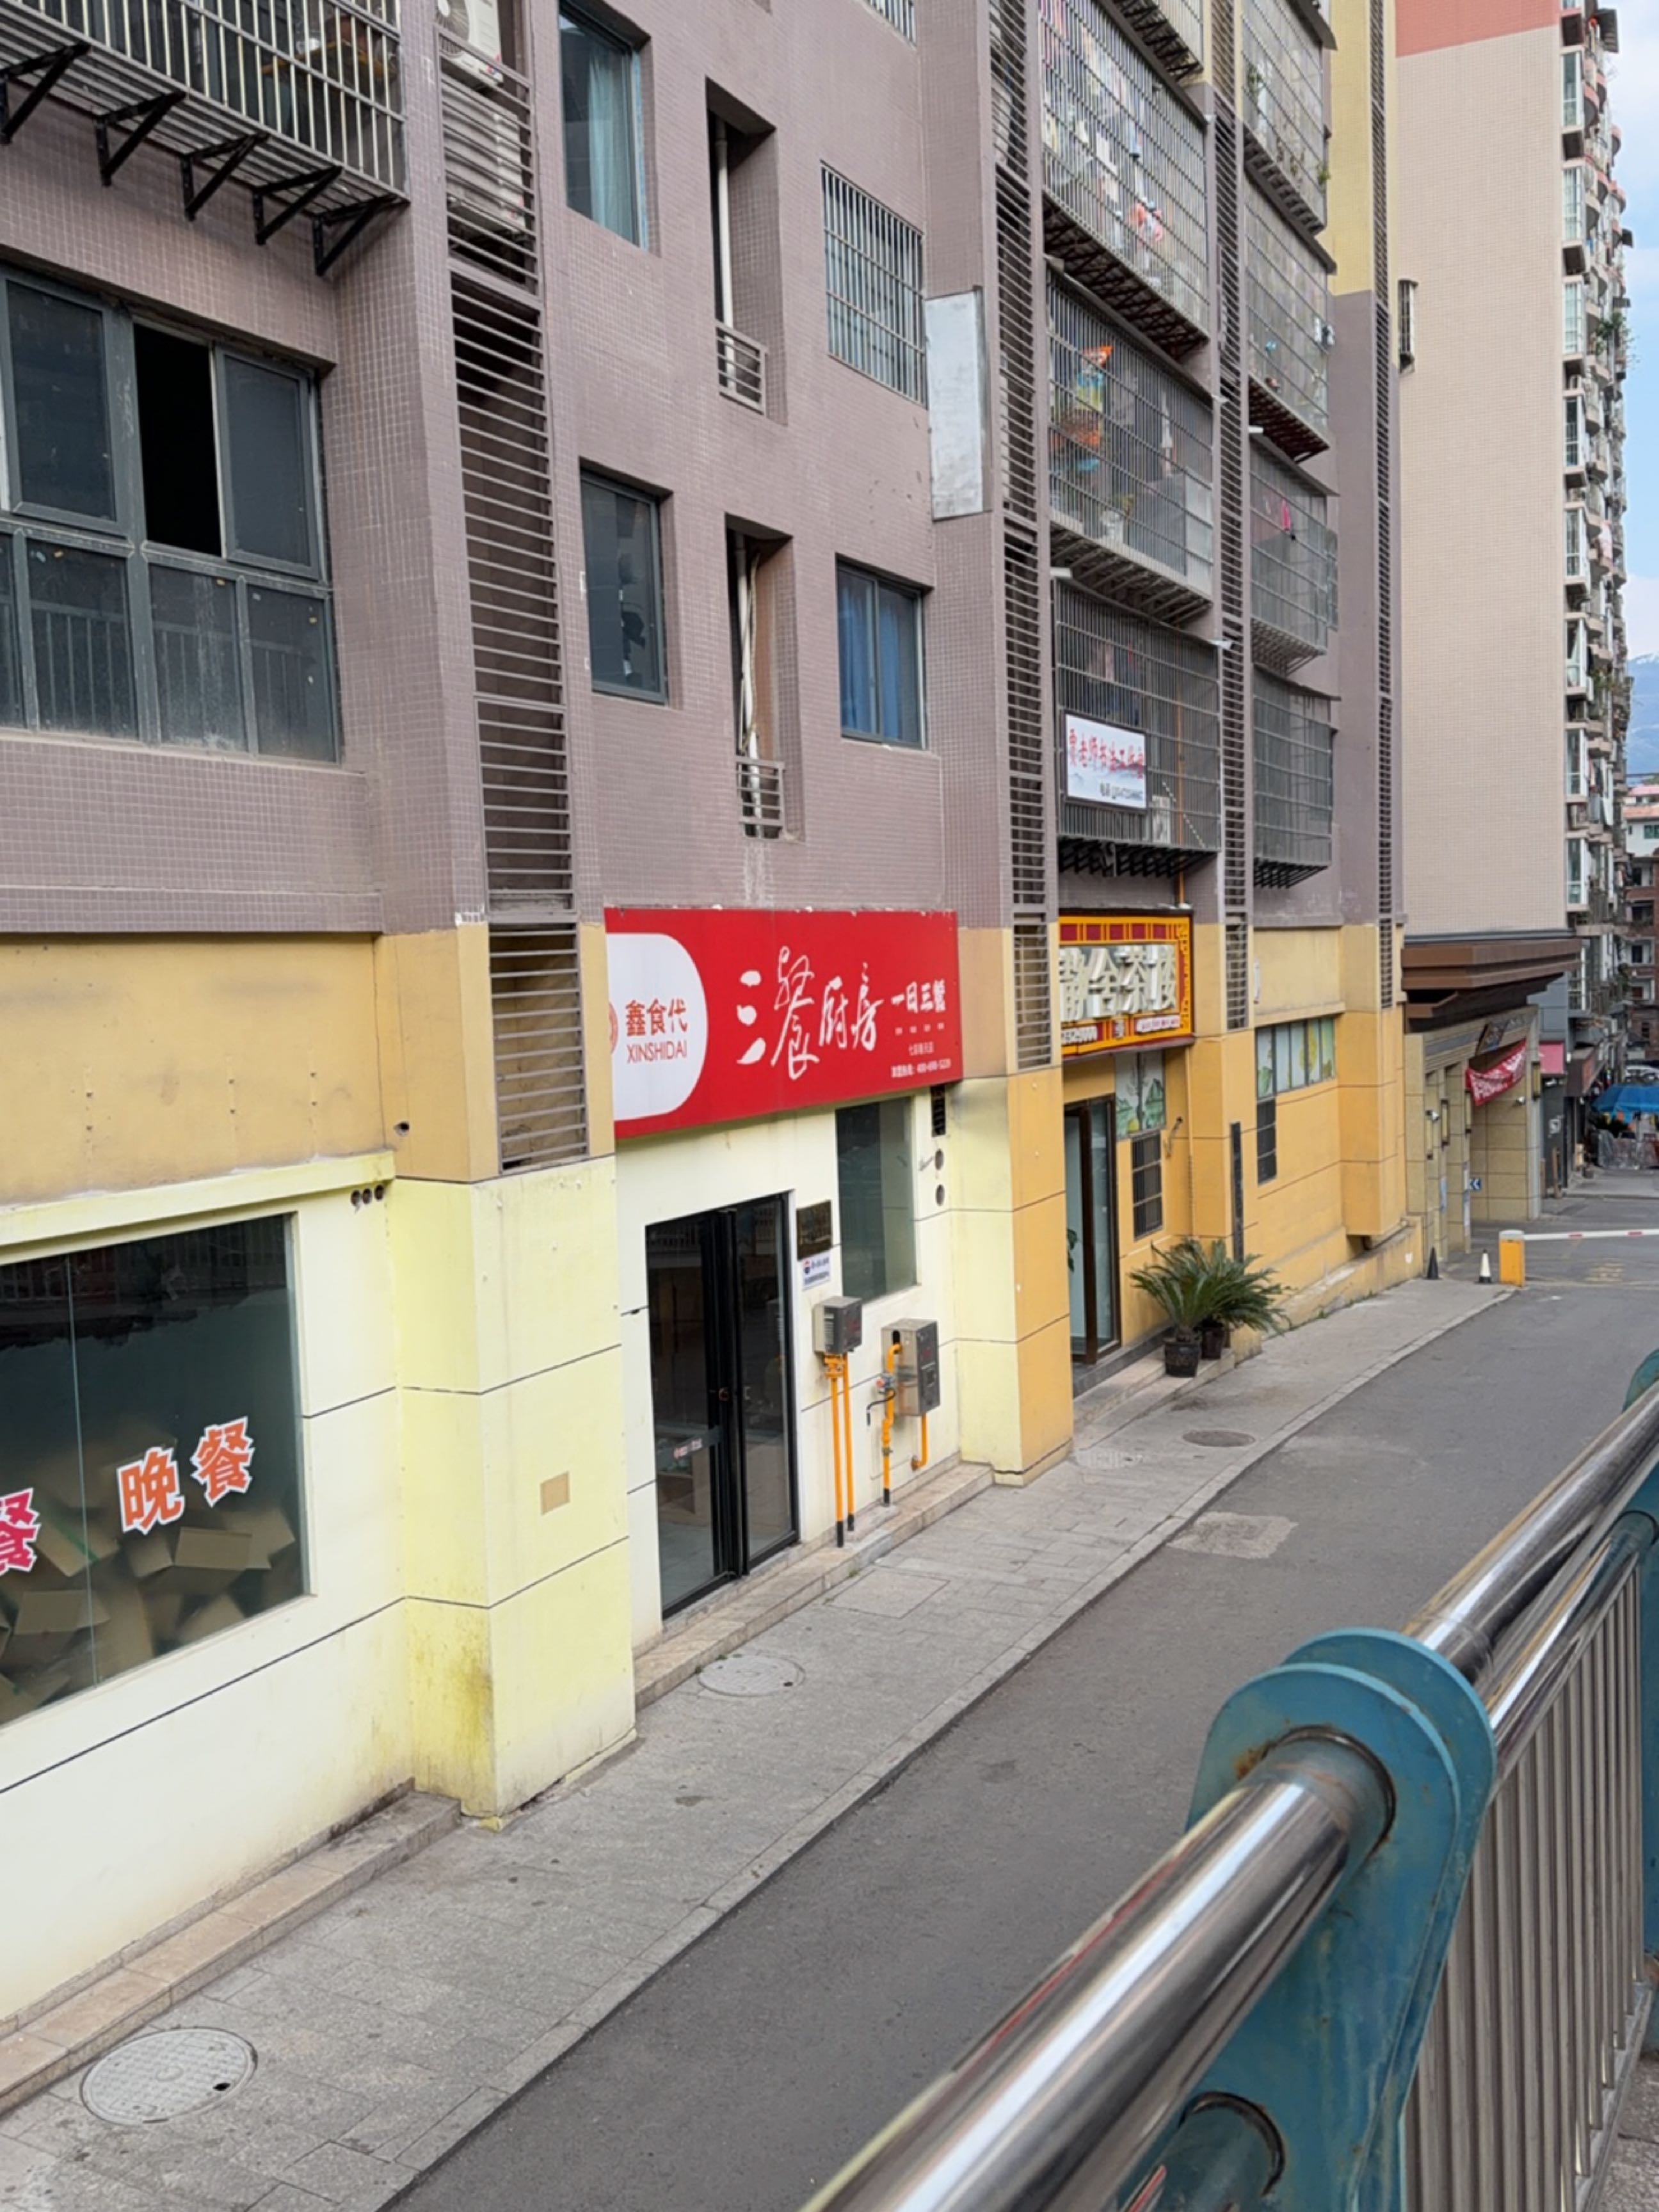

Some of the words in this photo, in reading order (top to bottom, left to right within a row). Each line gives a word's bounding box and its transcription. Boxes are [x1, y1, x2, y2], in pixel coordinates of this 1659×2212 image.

[625, 998, 688, 1037] 鑫食代
[627, 1039, 687, 1064] XINSHIDAI
[116, 1416, 255, 1535] 晚餐
